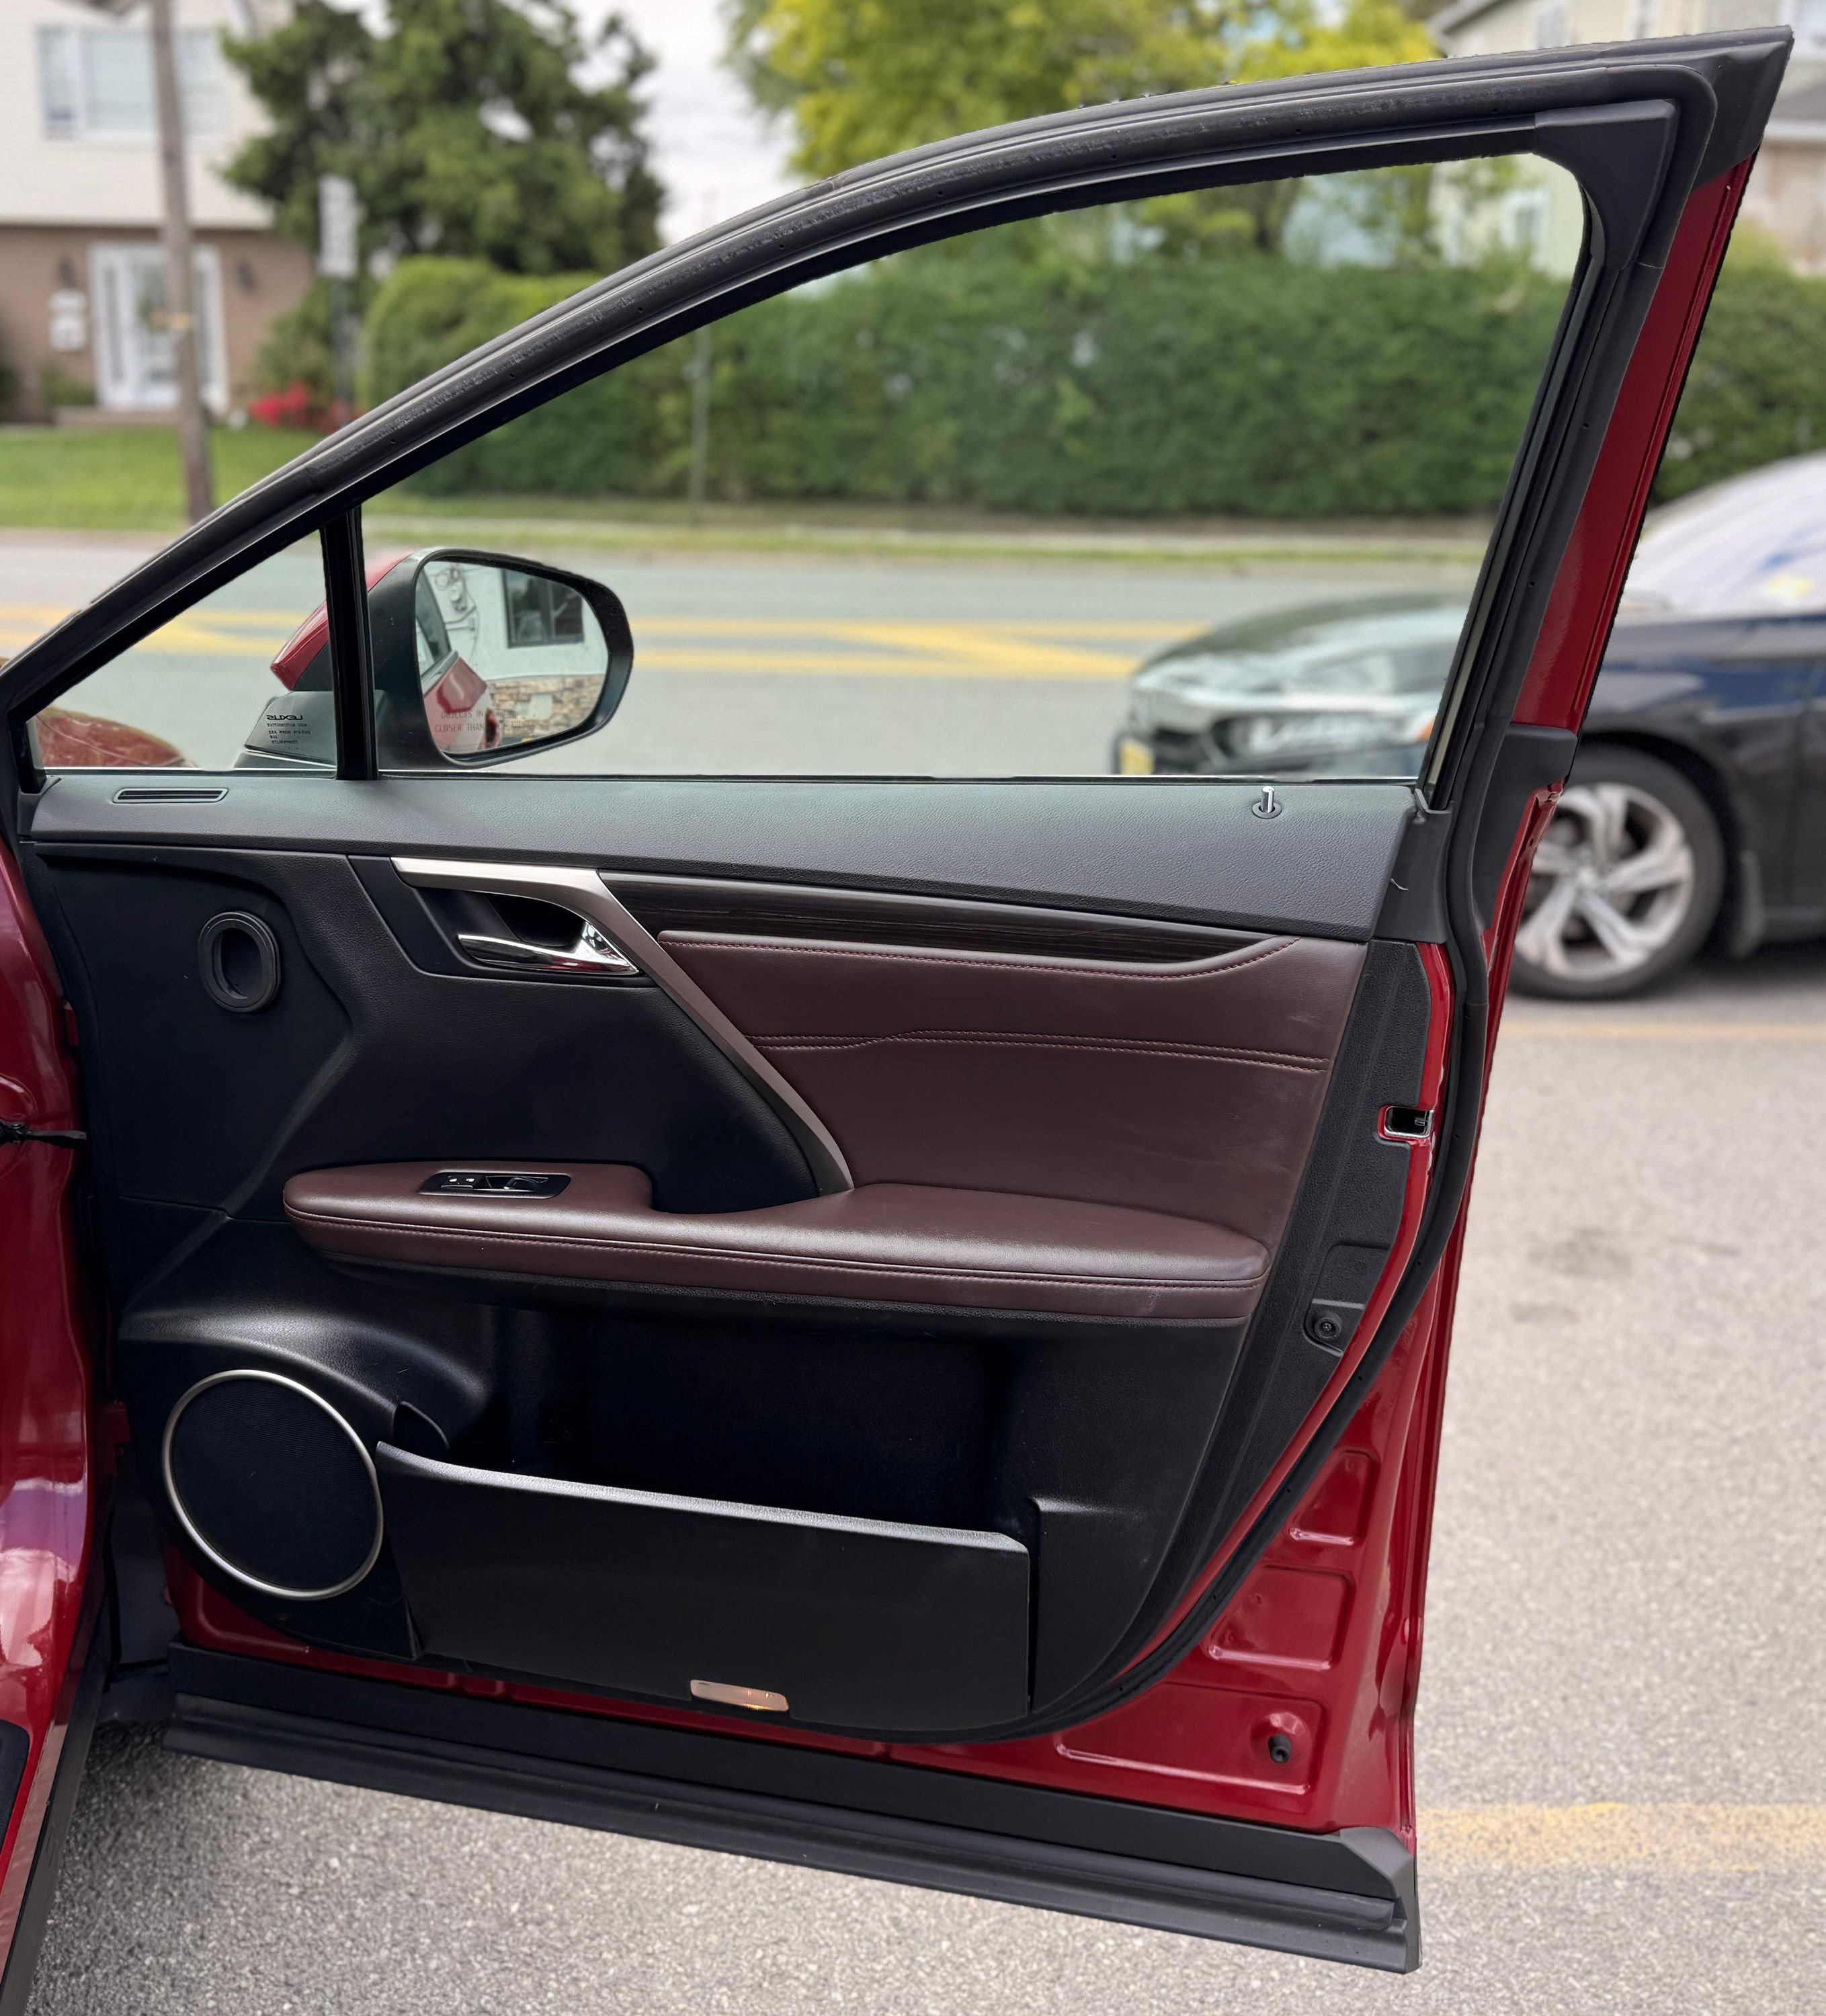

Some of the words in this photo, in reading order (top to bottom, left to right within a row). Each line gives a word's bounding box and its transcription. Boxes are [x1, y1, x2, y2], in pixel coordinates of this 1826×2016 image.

[441, 710, 472, 719] OBJECTS
[476, 709, 484, 718] IN
[434, 723, 462, 732] CLOSER
[466, 722, 485, 732] THAN
